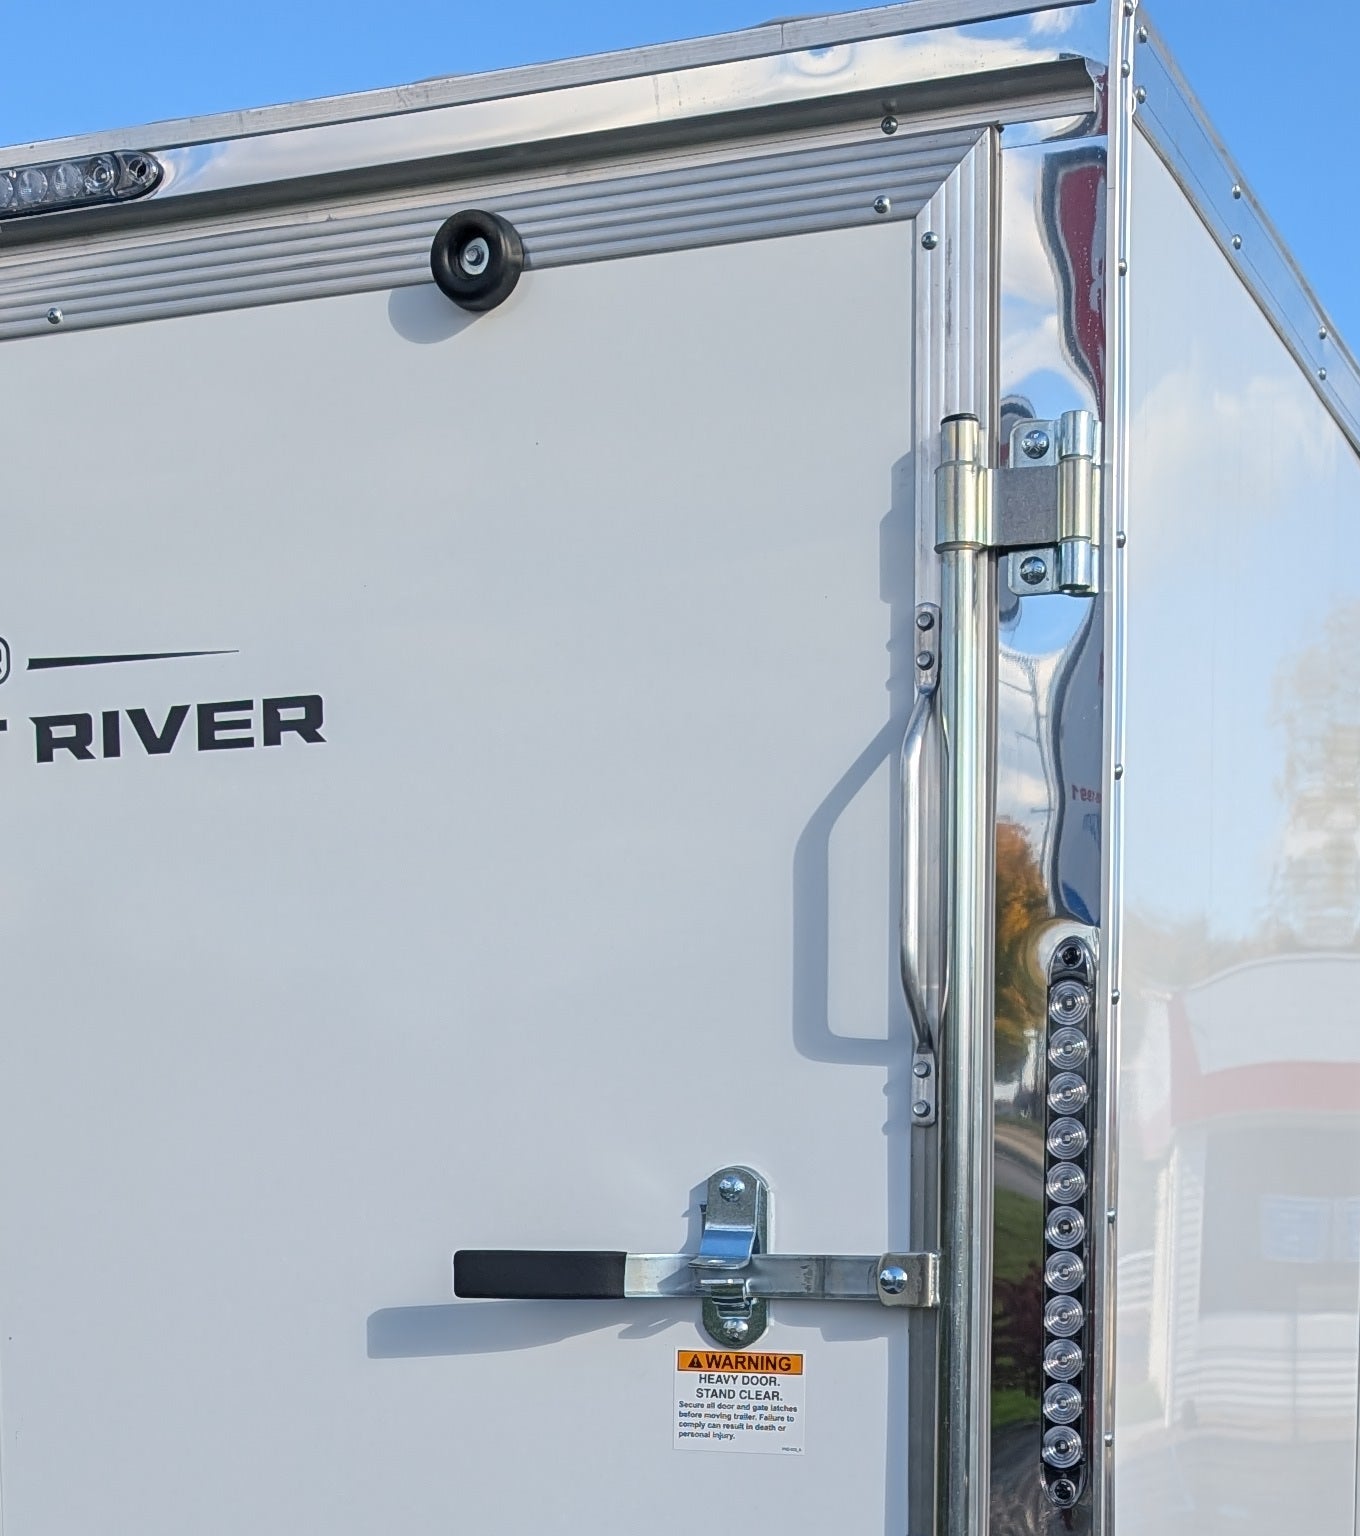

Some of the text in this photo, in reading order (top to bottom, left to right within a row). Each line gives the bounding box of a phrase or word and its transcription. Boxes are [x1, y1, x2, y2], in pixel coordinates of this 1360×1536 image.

[29, 694, 328, 765] RIVER
[705, 1354, 792, 1372] WARNING
[698, 1373, 781, 1387] HEAVY DOOR.
[695, 1388, 783, 1402] STAND CLEAR.
[678, 1400, 705, 1409] Secure
[706, 1401, 715, 1409] all
[717, 1402, 735, 1410] door
[752, 1404, 768, 1412] gate
[770, 1404, 798, 1413] latches
[678, 1410, 702, 1419] before
[704, 1412, 732, 1420] moving
[733, 1412, 757, 1420] trailer.
[759, 1413, 785, 1422] Failure
[678, 1421, 705, 1430] comply
[723, 1422, 744, 1430] result
[755, 1423, 776, 1431] death
[678, 1431, 735, 1440] personal injury.
